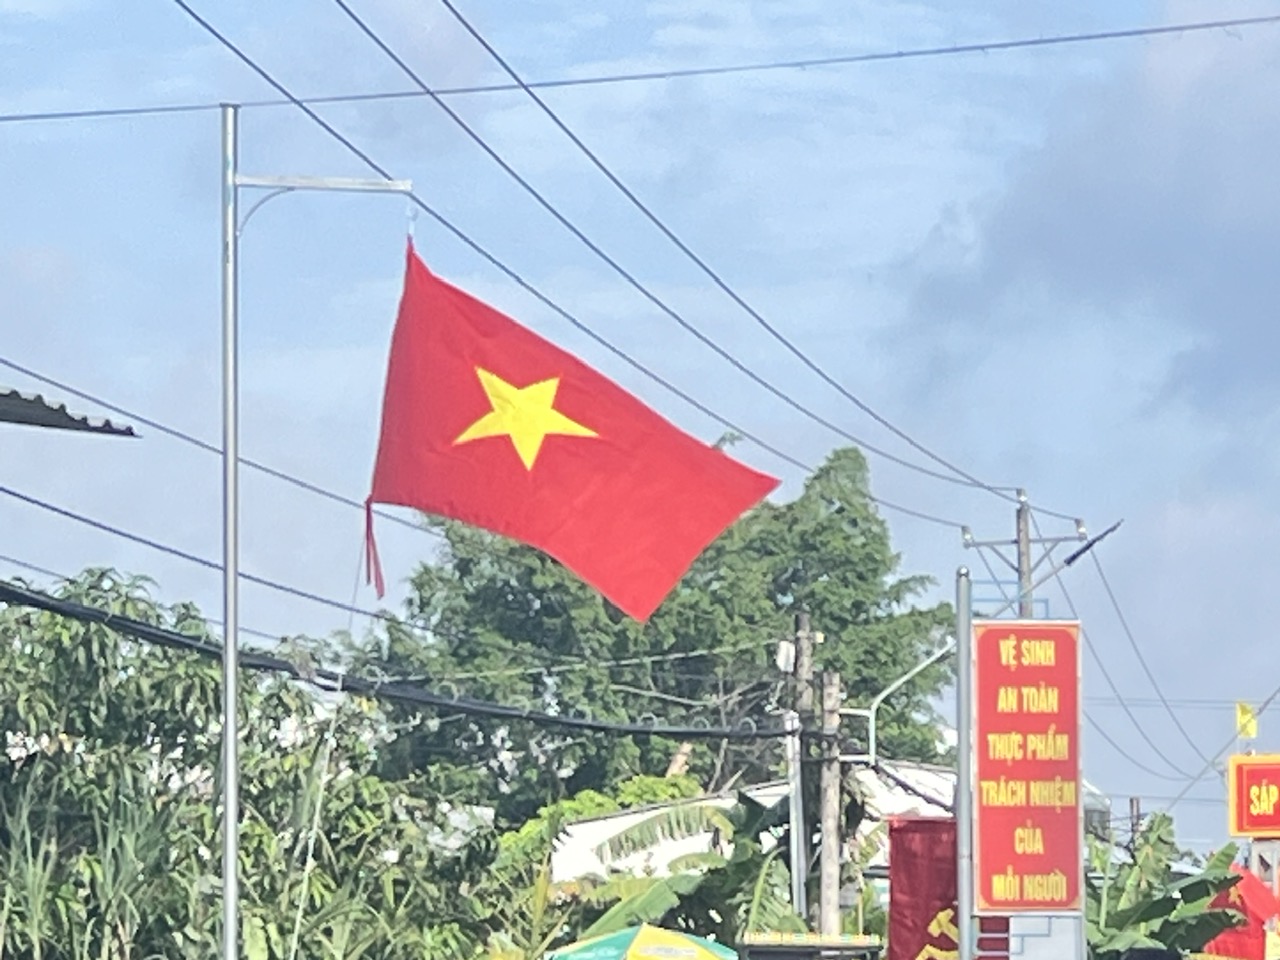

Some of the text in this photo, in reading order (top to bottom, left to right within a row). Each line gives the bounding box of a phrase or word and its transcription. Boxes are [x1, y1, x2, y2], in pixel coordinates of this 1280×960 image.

[1021, 639, 1056, 666] SINH
[997, 681, 1058, 713] AN TOÀN
